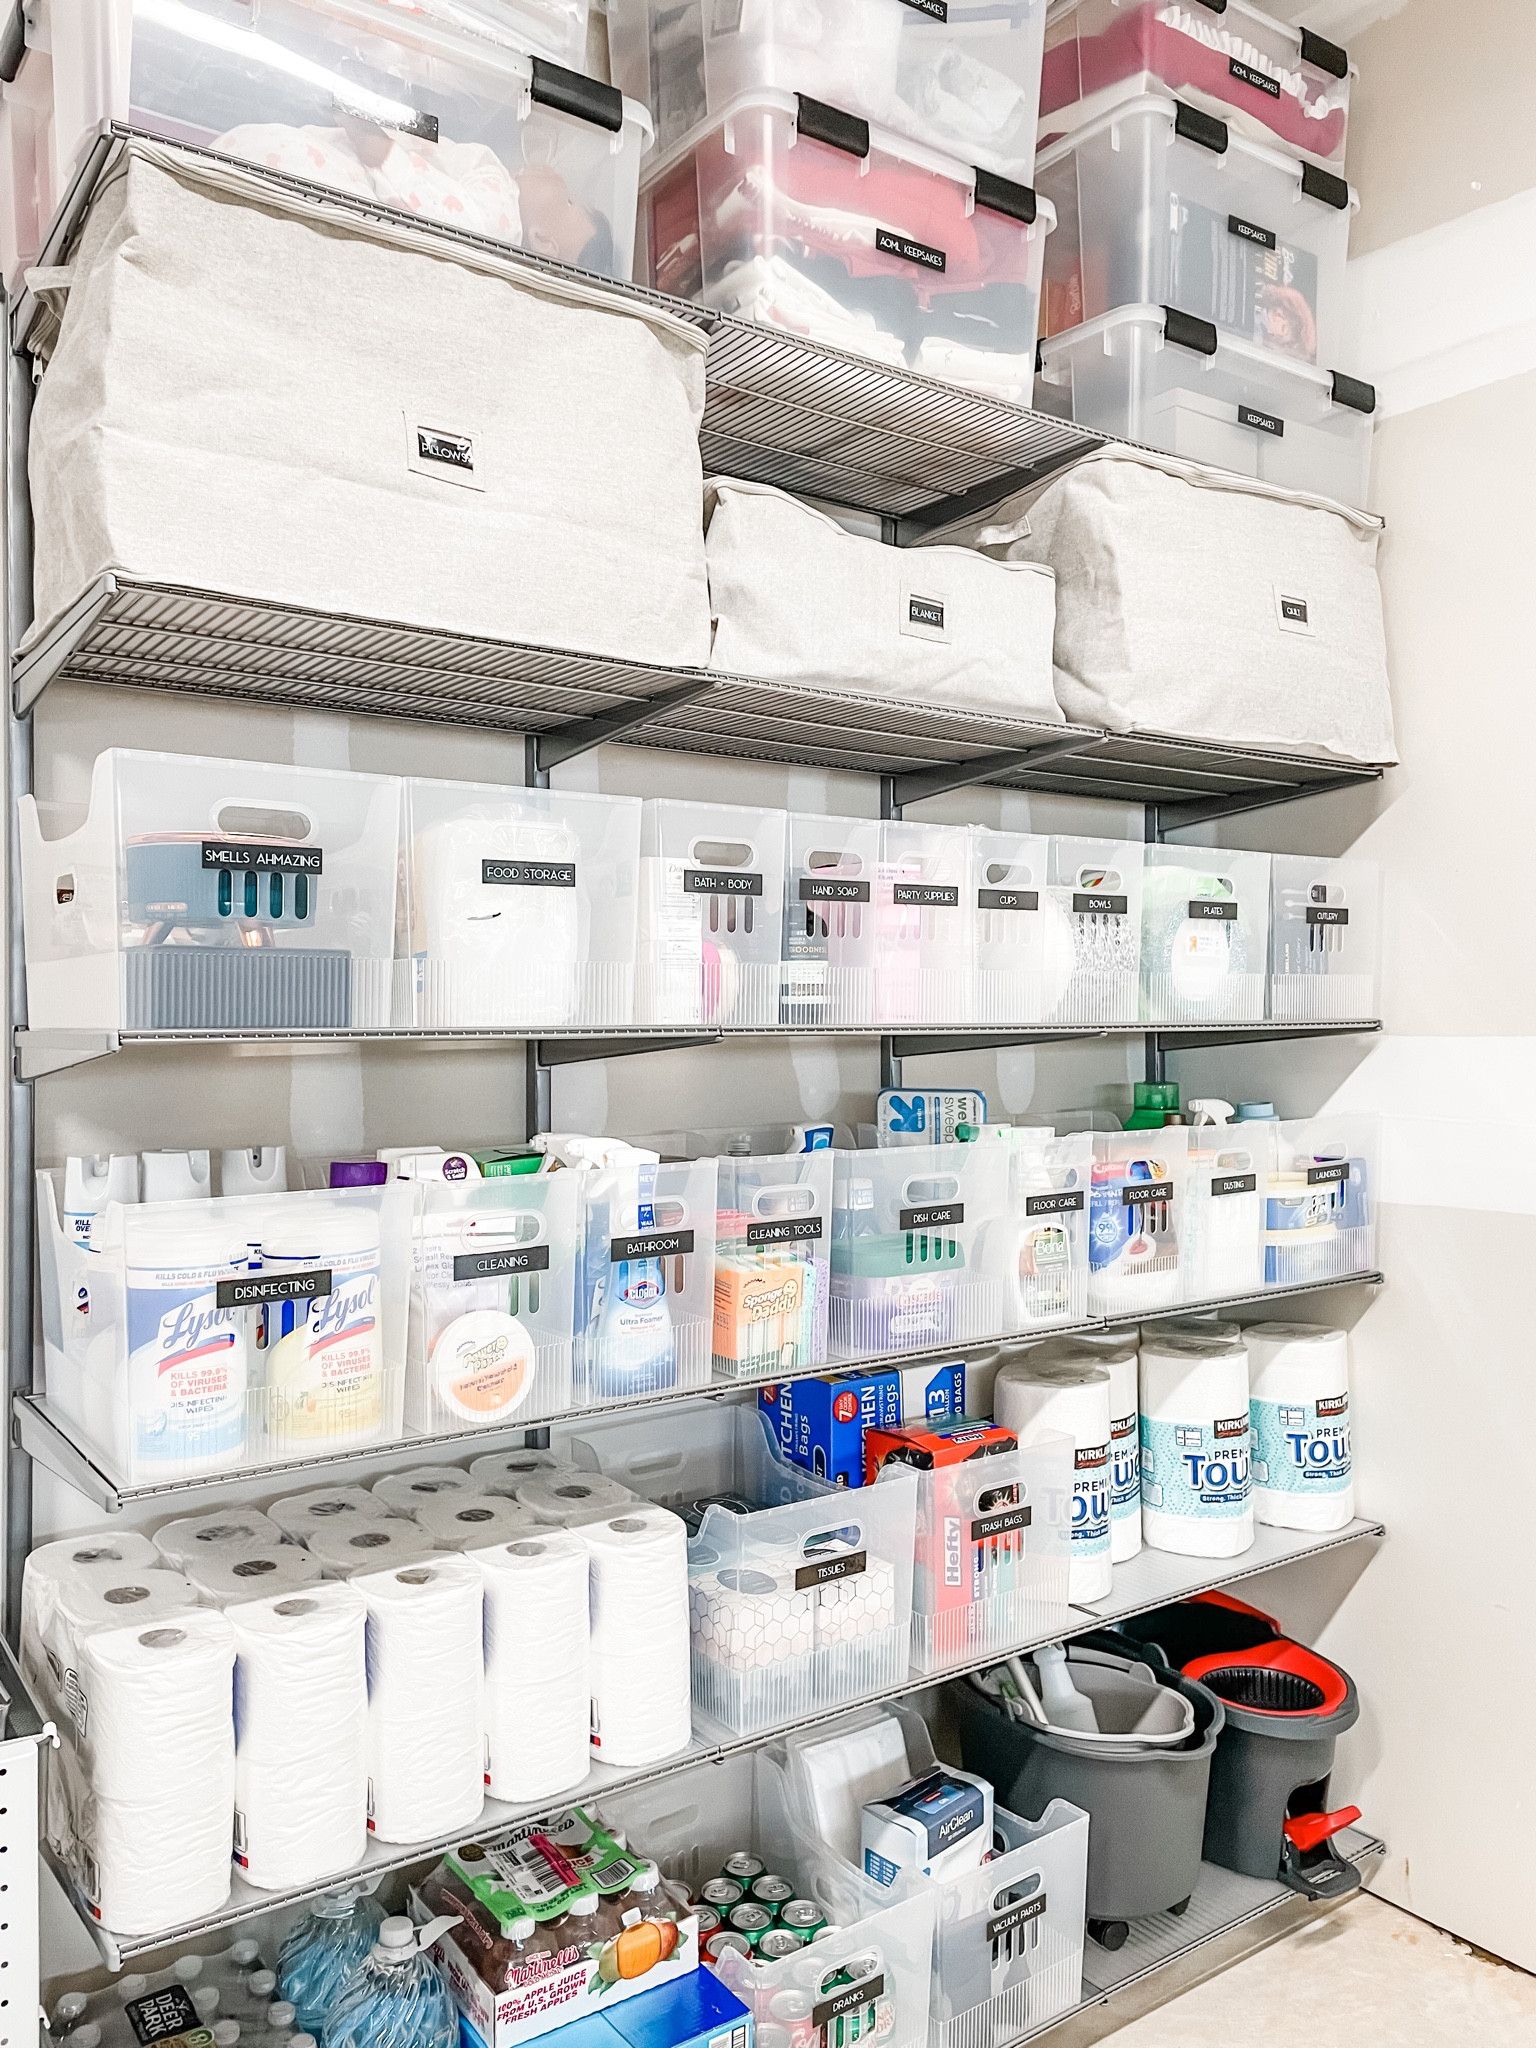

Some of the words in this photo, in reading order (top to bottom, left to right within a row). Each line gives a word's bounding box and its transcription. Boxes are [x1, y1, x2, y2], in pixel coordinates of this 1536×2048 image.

[911, 0, 944, 16] SAKES
[1249, 73, 1278, 94] KEEPSAKES
[1238, 223, 1267, 243] KEEPSAKES
[880, 236, 901, 252] AOML
[903, 244, 943, 267] KEEPSAKES
[1247, 413, 1275, 430] KEEPSAKES
[421, 442, 468, 463] PILLOWS
[911, 606, 942, 622] BLANKET
[205, 849, 250, 864] SMELLS
[256, 852, 320, 868] AHMAZING
[487, 866, 519, 879] FOOD
[523, 868, 572, 881] STORAGE
[694, 876, 717, 888] BATH
[727, 878, 753, 890] BODY
[812, 885, 834, 896] HAND
[837, 886, 859, 897] SOAP
[897, 889, 921, 900] PARTY
[924, 891, 955, 901] SUPPLIES
[999, 895, 1018, 905] CUPS
[1088, 899, 1112, 909] BOWLS
[1203, 906, 1224, 916] PLATES
[1316, 911, 1339, 921] CUTLERY
[943, 1096, 955, 1143] sweep
[444, 1166, 466, 1175] Scratch
[1129, 1190, 1149, 1200] FLOOR
[1150, 1187, 1168, 1198] CARE
[1223, 1180, 1245, 1191] DUSTING
[1033, 1200, 1056, 1211] FLOOR
[1058, 1197, 1077, 1208] CARE
[913, 1212, 929, 1224] DISH
[931, 1210, 952, 1222] CARE
[749, 1226, 790, 1241] CLEANING
[793, 1223, 822, 1236] TOOLS
[627, 1238, 679, 1254] BATHROOM
[1036, 1241, 1064, 1256] Bona
[323, 1259, 342, 1267] COLD
[347, 1257, 359, 1265] FLU
[476, 1255, 529, 1272] CLEANING
[177, 1272, 196, 1280] COLD
[203, 1271, 217, 1279] FLU
[234, 1279, 316, 1300] DISINFECTING
[743, 1287, 784, 1308] Sponge
[312, 1275, 375, 1332] Lysol
[752, 1294, 797, 1322] Daddy
[620, 1318, 639, 1326] Ultra
[639, 1315, 664, 1325] Foamer
[321, 1352, 346, 1361] KILLS
[321, 1362, 334, 1370] OF
[337, 1354, 371, 1367] VIRUSES
[170, 1370, 198, 1381] KILLS
[201, 1366, 228, 1377] 99.9%
[330, 1362, 371, 1377] BACTERIA
[170, 1380, 184, 1389] OF
[187, 1374, 228, 1387] VIRUSES
[170, 1389, 177, 1397] &
[180, 1382, 227, 1396] BACTERIA
[954, 1372, 963, 1401] BAGS
[170, 1395, 228, 1408] DISNFECTIN
[186, 1404, 214, 1414] WIPES
[884, 1384, 899, 1423] Bags
[929, 1388, 945, 1417] 13
[780, 1382, 793, 1454] TCHEN
[838, 1410, 853, 1421] 7
[799, 1415, 811, 1456] Bags
[953, 1433, 984, 1443] Hefty
[981, 1520, 1002, 1534] TRASH
[1004, 1514, 1023, 1526] BAGS
[946, 1520, 961, 1583] Hefty
[817, 1562, 846, 1579] TISSUES
[938, 1809, 974, 1839] AirClean
[993, 1913, 1019, 1933] VACUUM
[1020, 1901, 1041, 1919] PARTS
[497, 1998, 521, 2013] 100%
[523, 1982, 555, 2002] APPLE
[557, 1968, 587, 1987] JUICE
[496, 2005, 525, 2022] FROM
[527, 1997, 546, 2008] U.S.
[549, 1978, 587, 1999] GROWN
[504, 2008, 538, 2025] FRESH
[540, 1989, 578, 2012] APPLES
[832, 1989, 864, 2013] DRANKS
[138, 1999, 167, 2037] PARK
[156, 1993, 184, 2030] DEER
